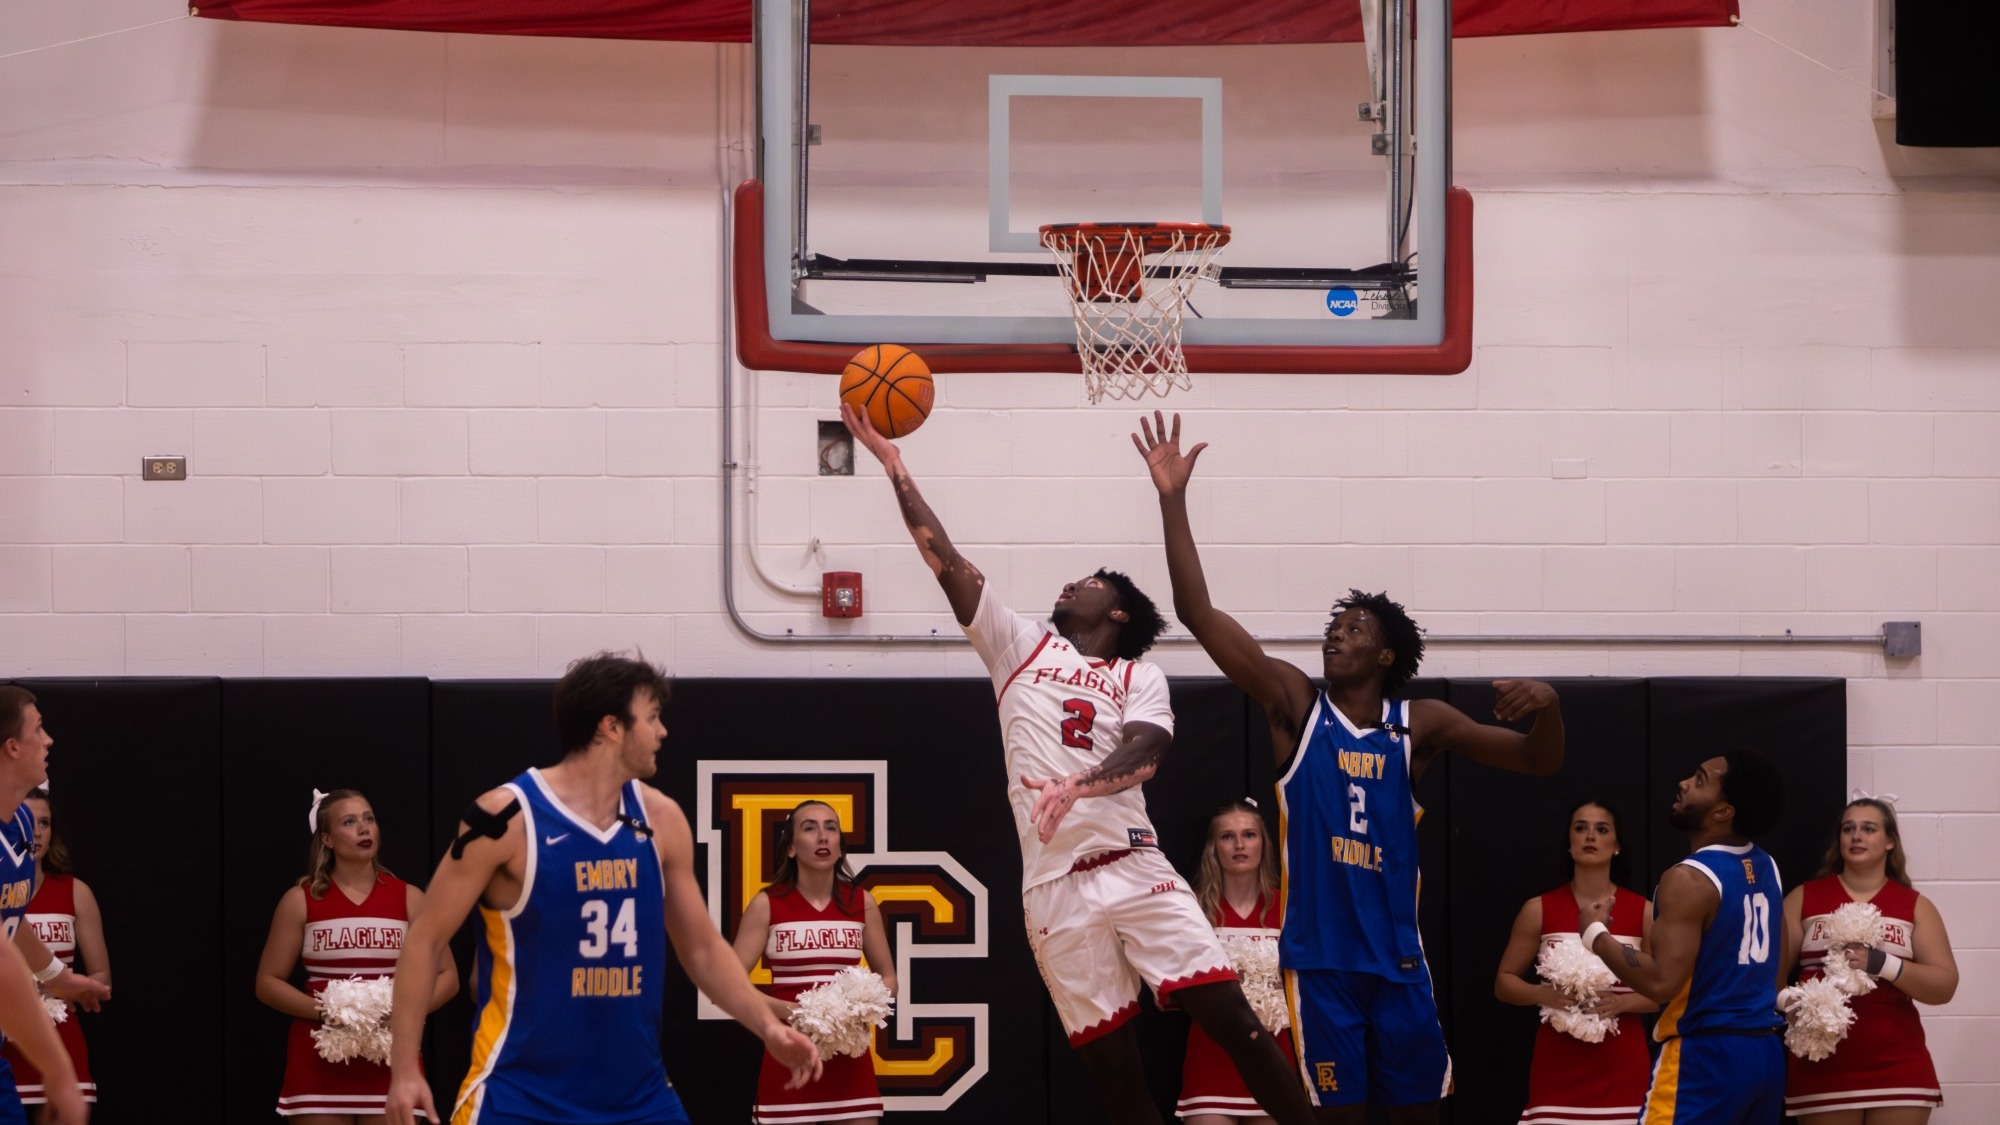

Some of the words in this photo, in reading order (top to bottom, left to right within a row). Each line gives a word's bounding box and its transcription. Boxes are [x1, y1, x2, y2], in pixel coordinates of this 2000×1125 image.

[1330, 300, 1356, 309] NCAA
[1033, 667, 1124, 711] FLAGLE
[1061, 697, 1097, 751] 2
[1347, 782, 1369, 835] 2
[575, 857, 638, 892] EMBRY
[313, 927, 402, 951] FLAGLER
[579, 897, 638, 958] 34
[776, 928, 863, 952] FLAGLER
[1737, 892, 1770, 965] 10
[572, 965, 642, 997] RIDDLE
